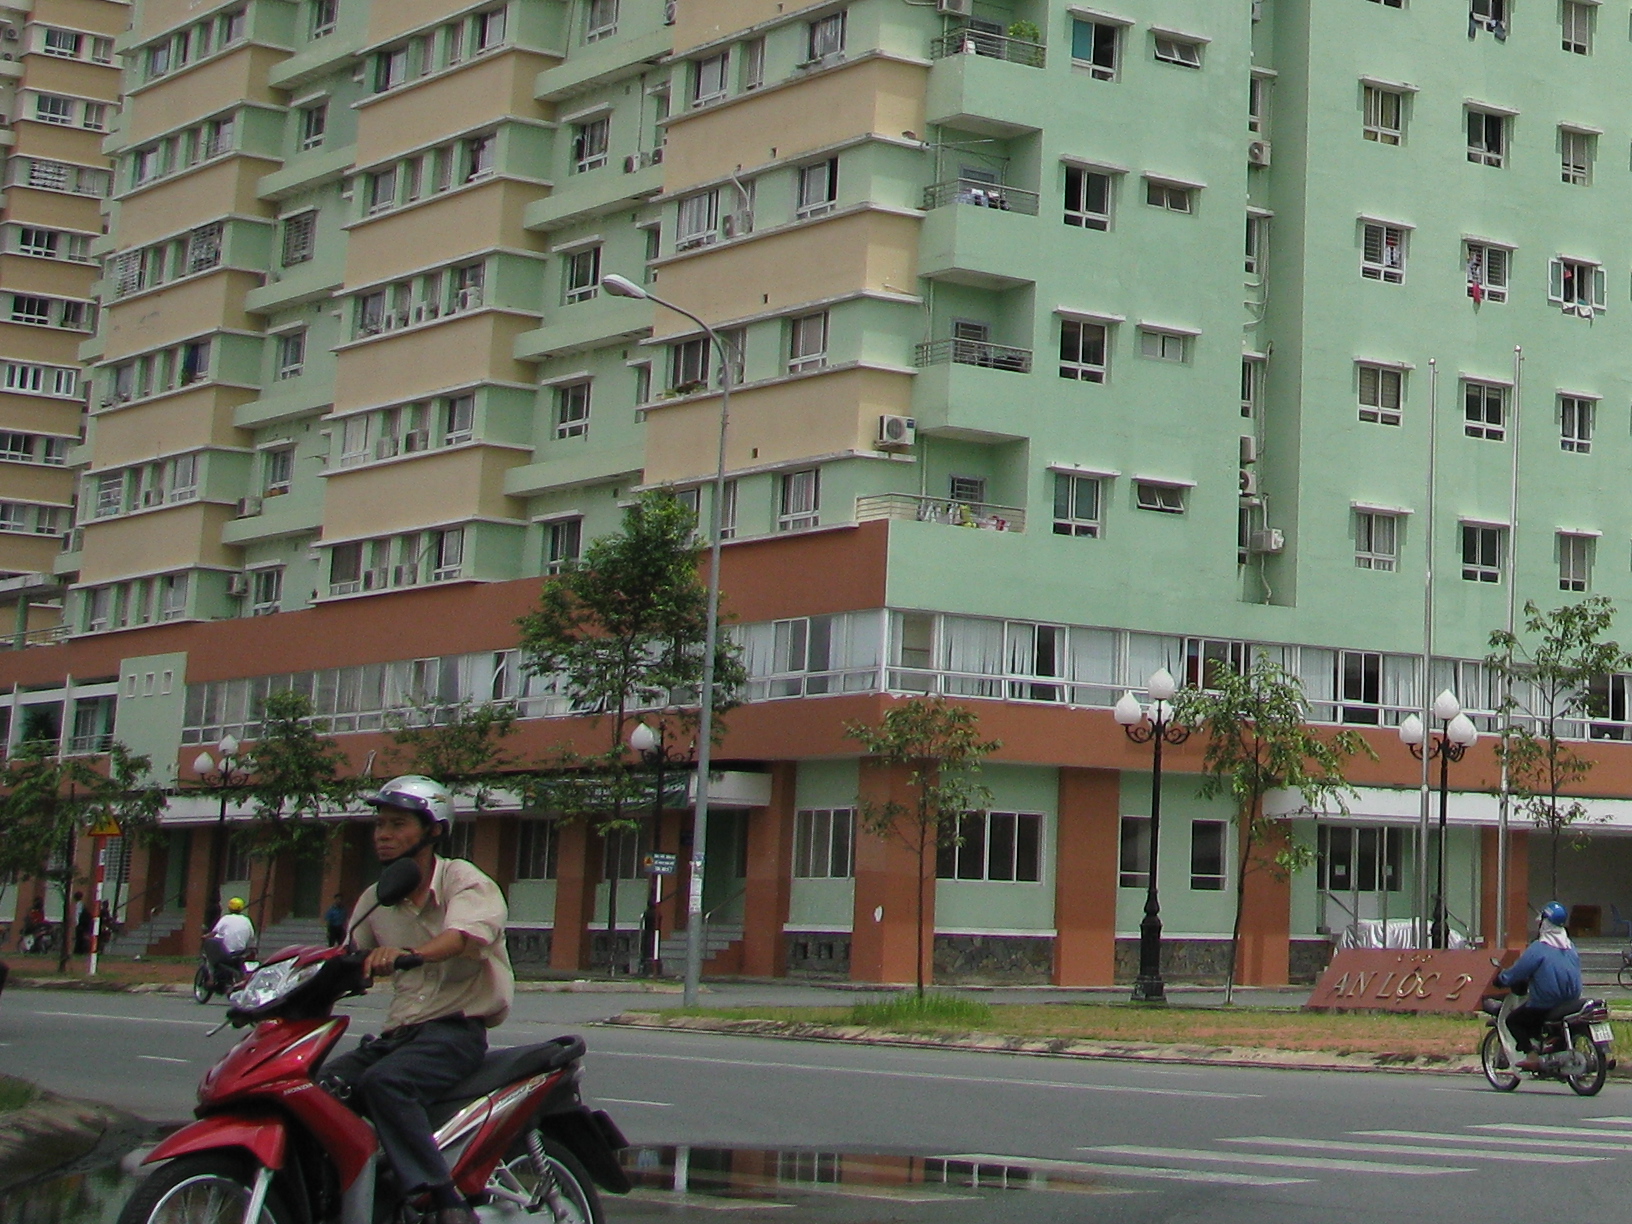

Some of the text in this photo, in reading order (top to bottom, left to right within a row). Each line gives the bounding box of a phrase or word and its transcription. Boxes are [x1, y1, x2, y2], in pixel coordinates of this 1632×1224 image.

[1328, 966, 1473, 1004] AN LỘC 2
